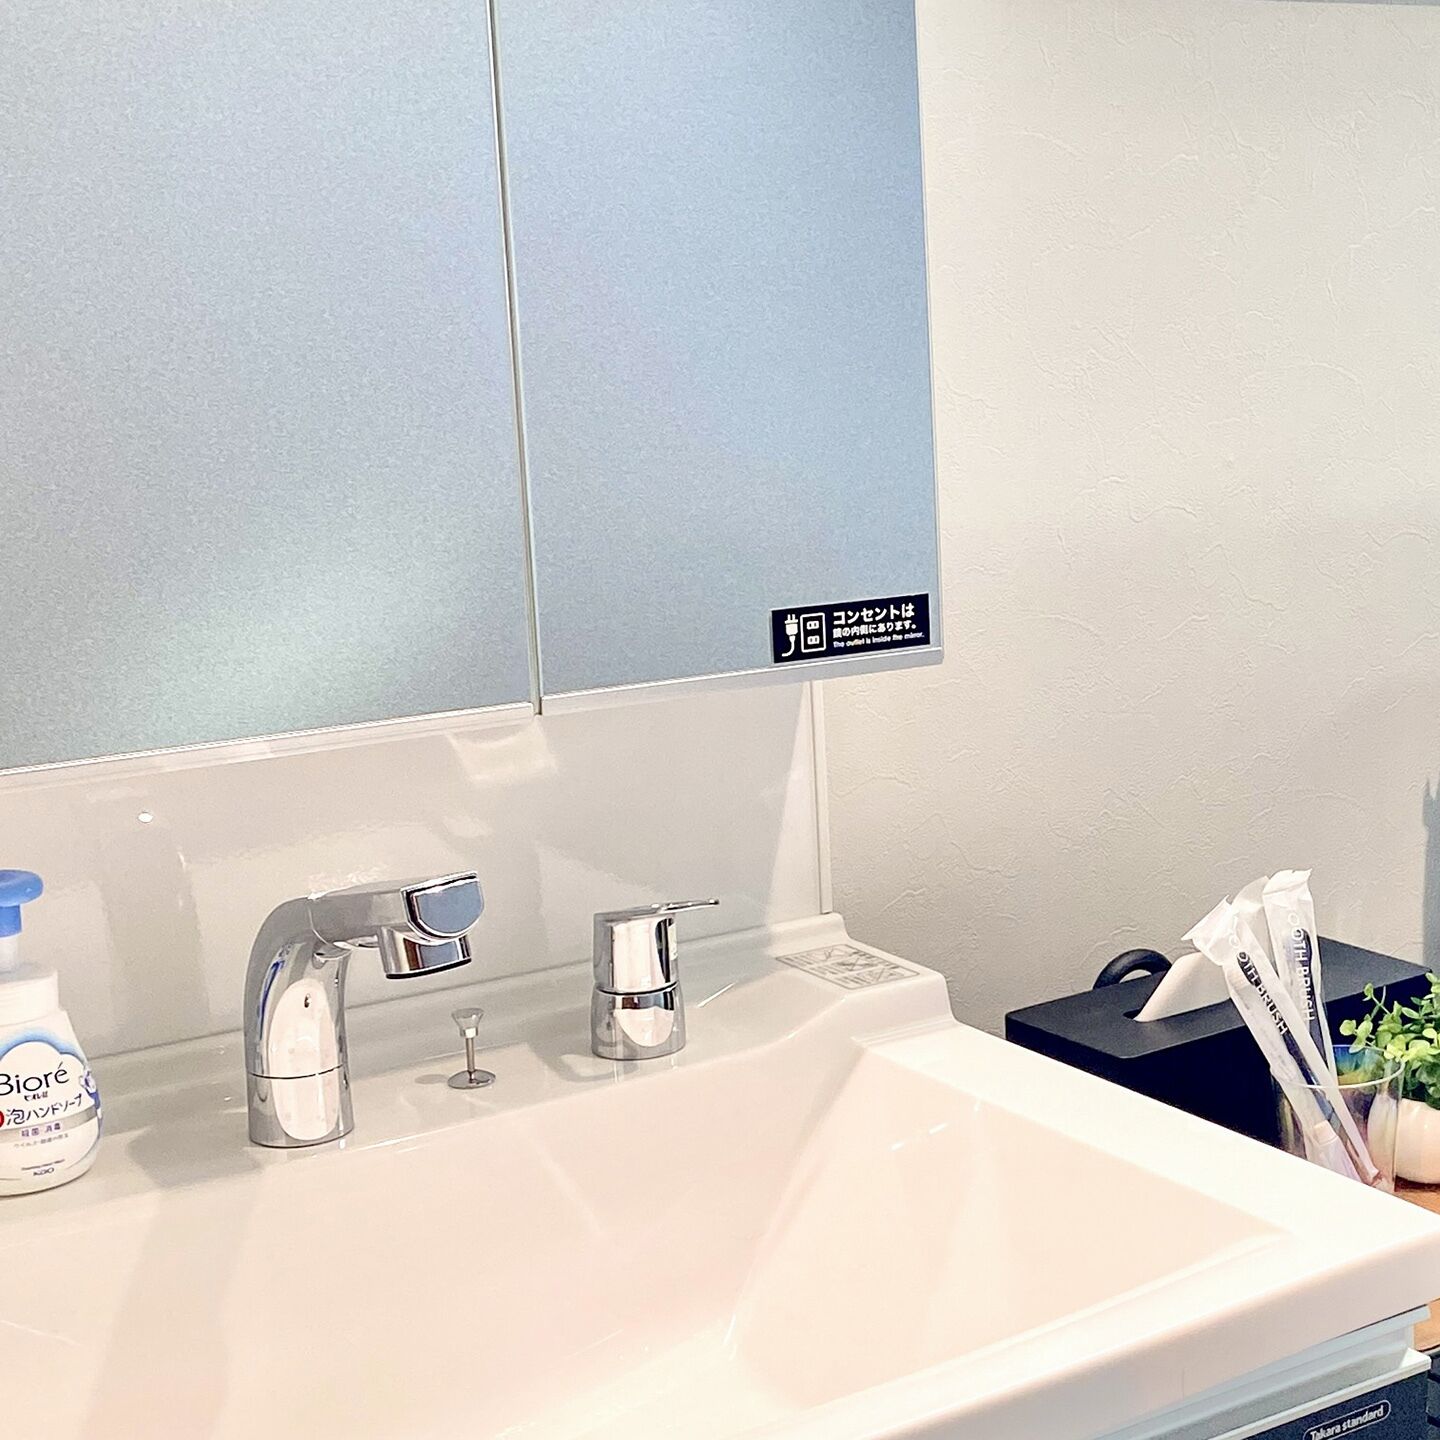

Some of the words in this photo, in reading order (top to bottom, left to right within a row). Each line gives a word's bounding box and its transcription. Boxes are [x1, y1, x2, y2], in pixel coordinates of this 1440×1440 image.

[833, 603, 914, 625] コンセントは
[832, 620, 917, 639] 鏡の内側にあります。
[846, 638, 865, 647] outlet
[872, 635, 891, 643] inside
[1256, 984, 1288, 1035] BRUSH
[6, 1093, 83, 1127] 泡ハンドソープ
[1310, 1423, 1341, 1440] Takara
[1342, 1405, 1384, 1429] standard
